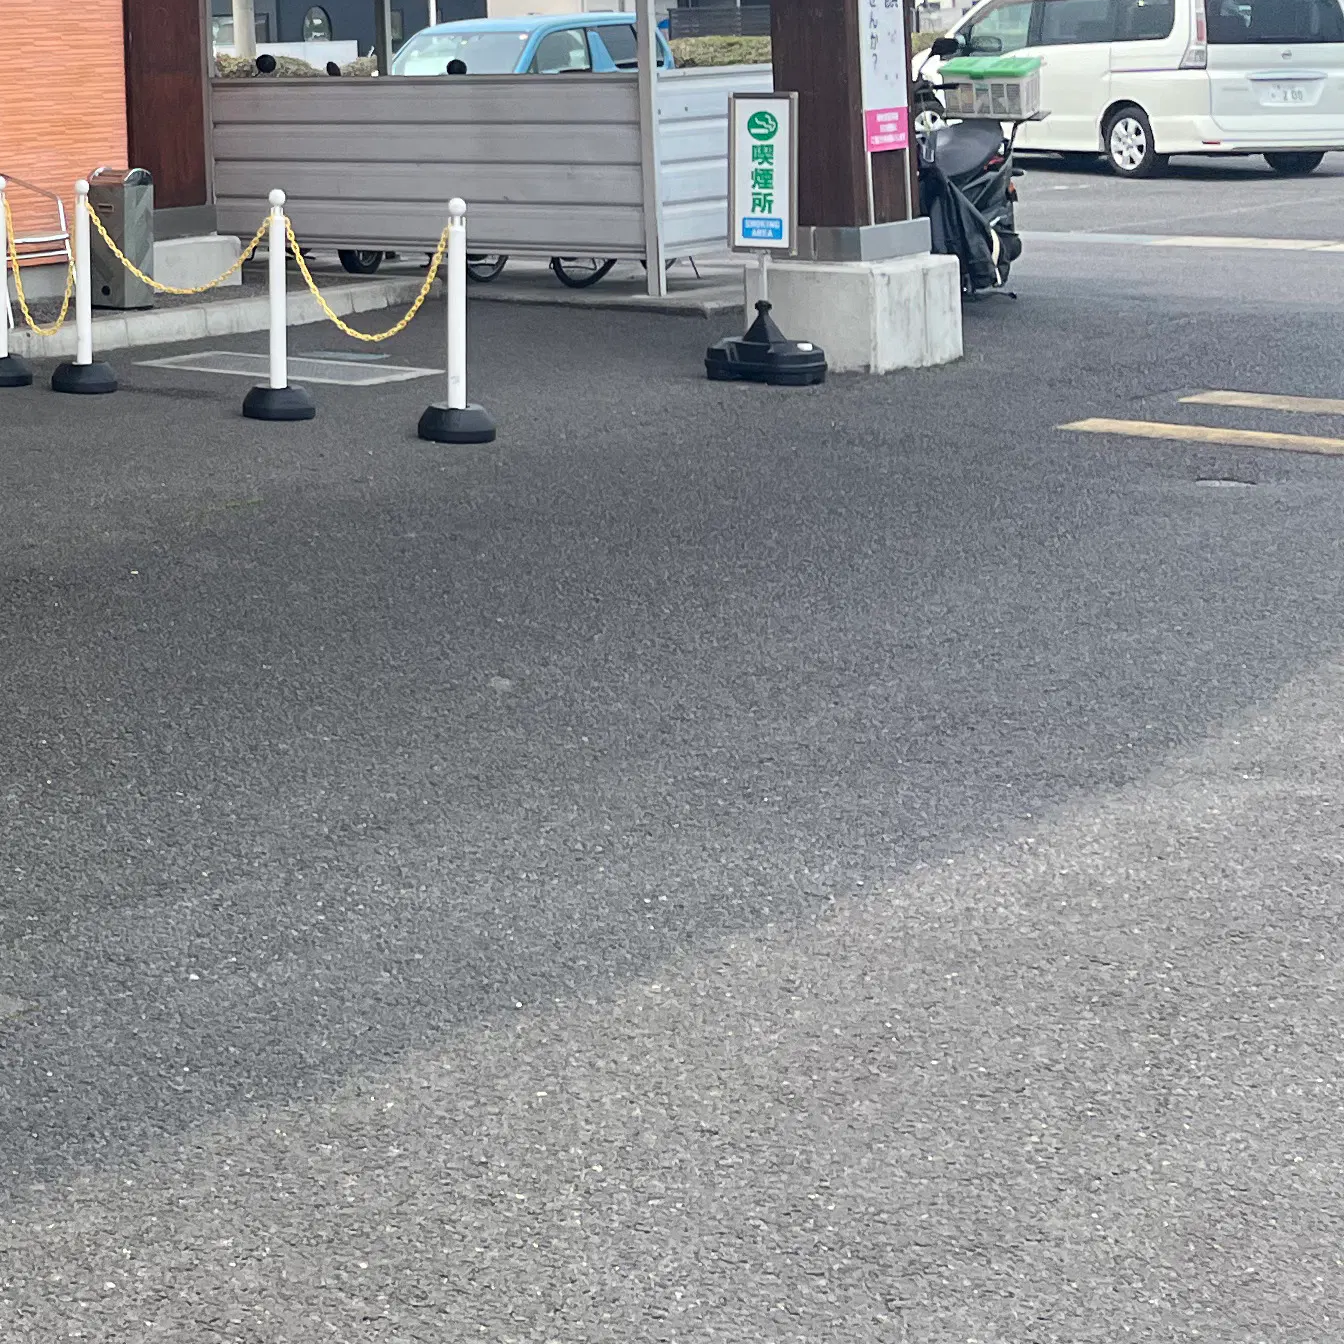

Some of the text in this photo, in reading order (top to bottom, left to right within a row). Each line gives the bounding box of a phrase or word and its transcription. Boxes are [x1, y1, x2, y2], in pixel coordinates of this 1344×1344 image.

[751, 144, 774, 214] 喫煙所
[745, 219, 781, 229] SMOKING
[751, 228, 774, 238] AREA
